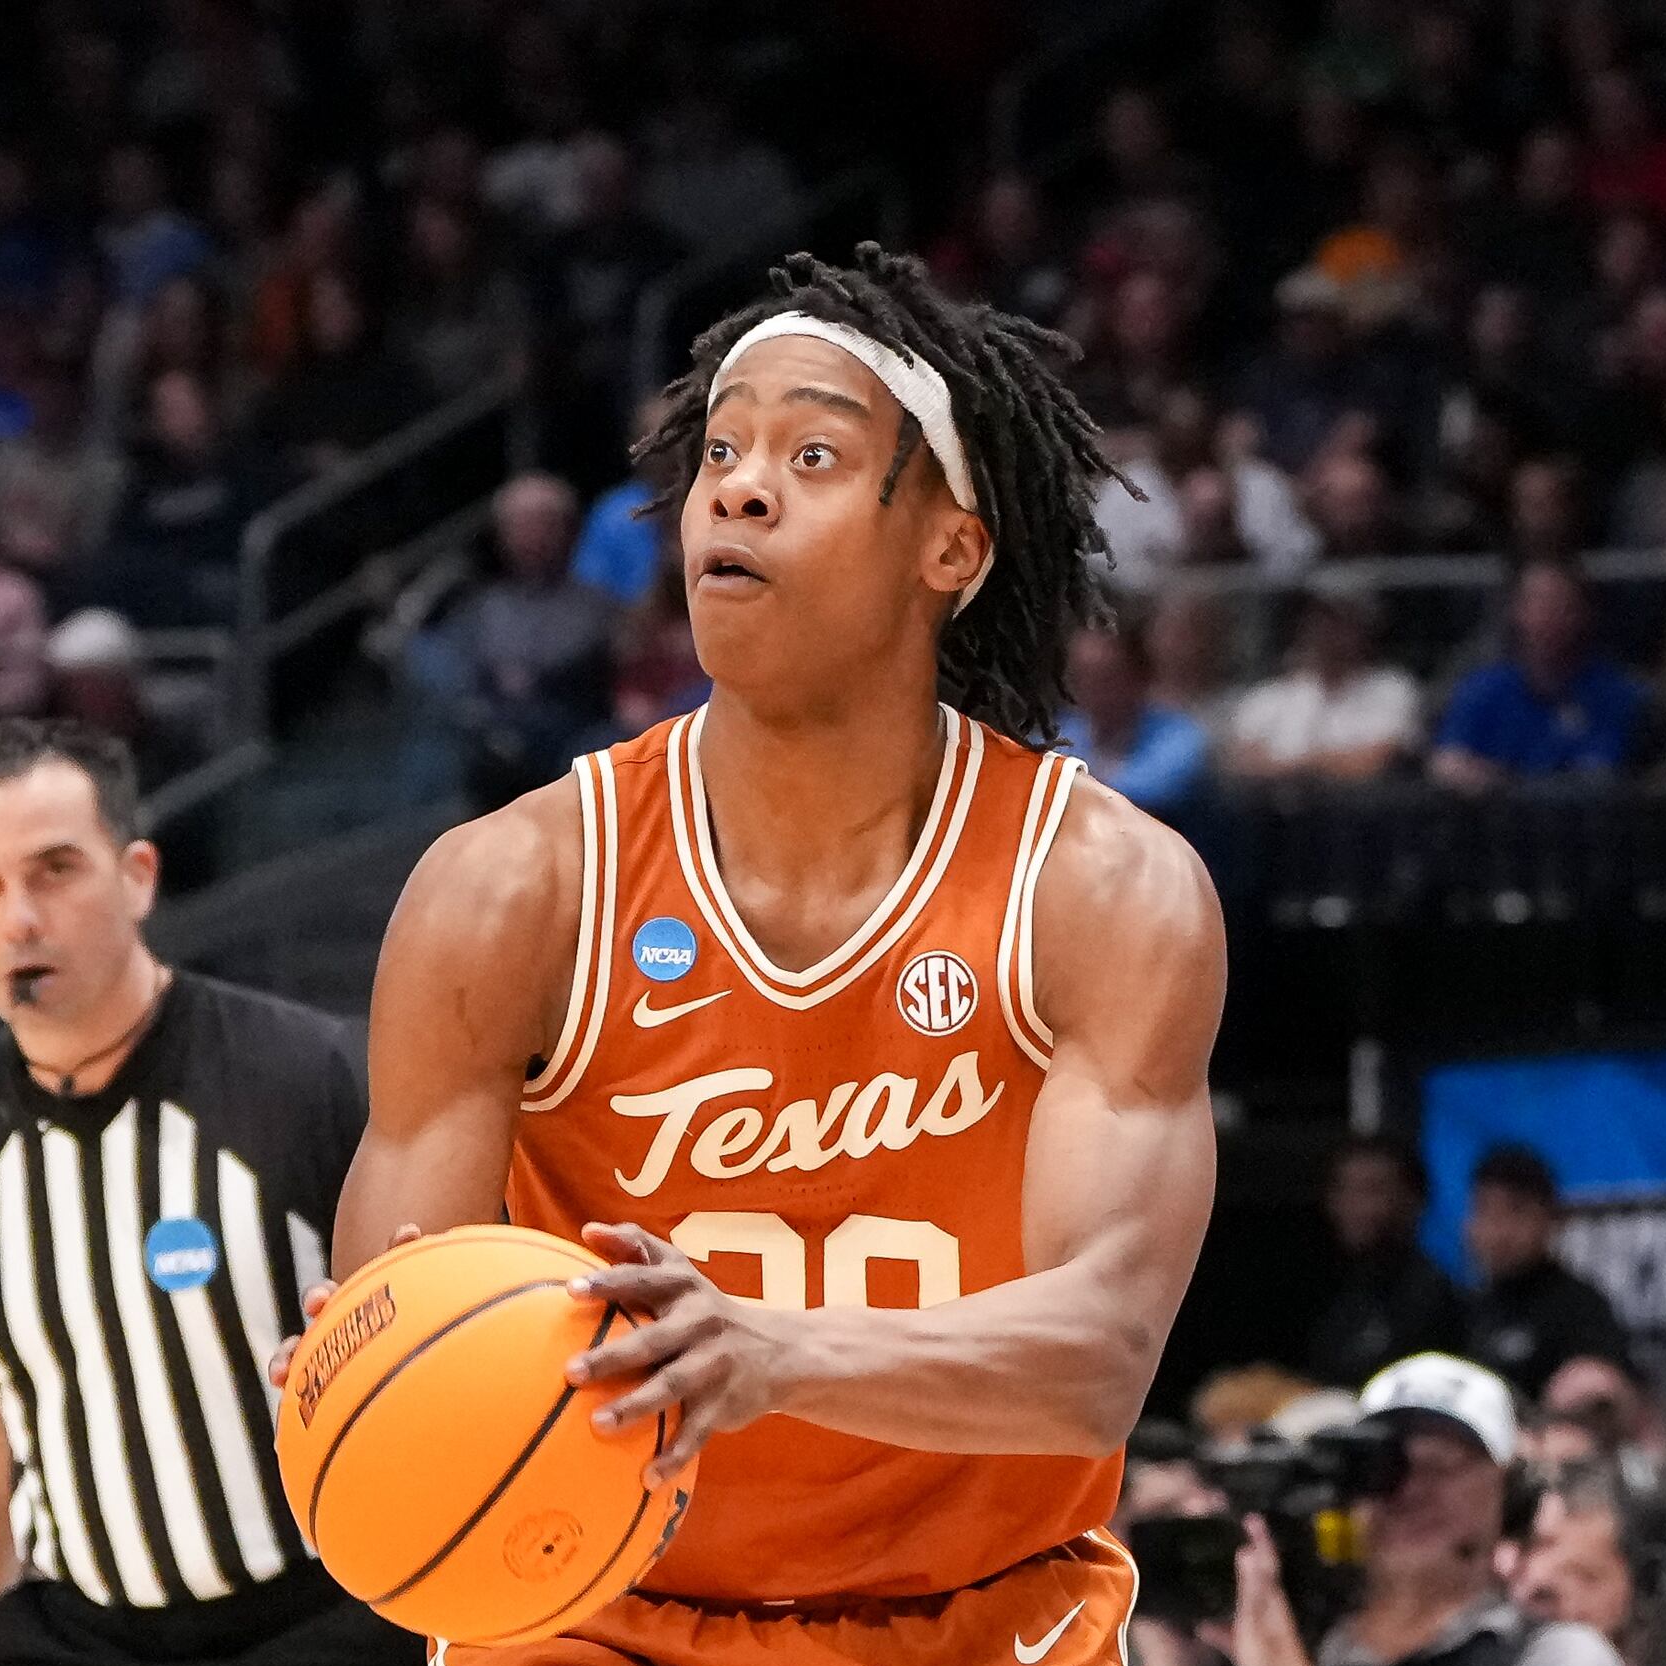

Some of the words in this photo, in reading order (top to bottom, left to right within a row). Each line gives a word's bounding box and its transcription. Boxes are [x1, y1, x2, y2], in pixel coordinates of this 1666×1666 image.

[639, 946, 693, 966] NCAA
[903, 957, 971, 1030] SEC
[610, 1051, 1005, 1198] Texas
